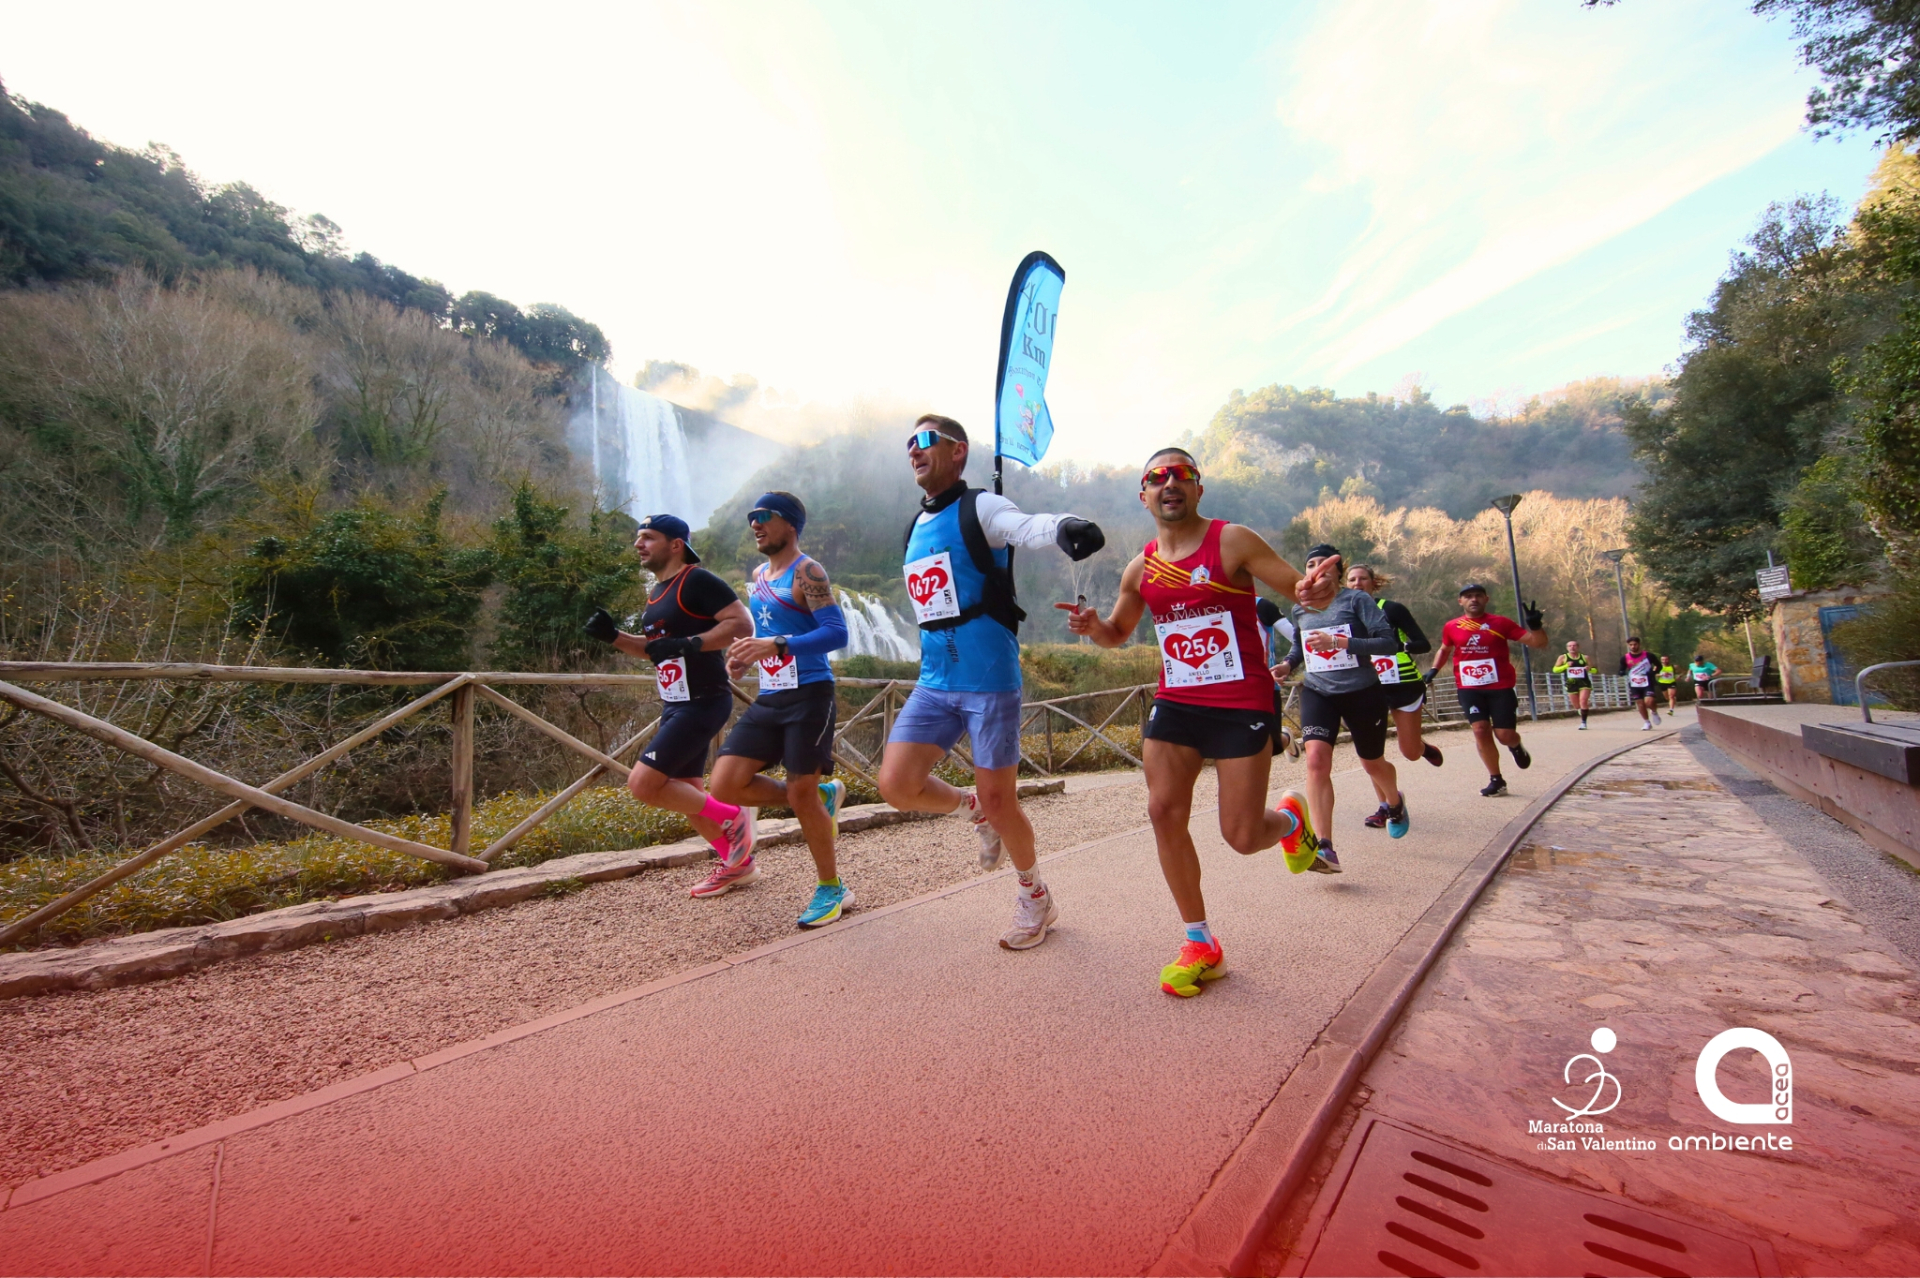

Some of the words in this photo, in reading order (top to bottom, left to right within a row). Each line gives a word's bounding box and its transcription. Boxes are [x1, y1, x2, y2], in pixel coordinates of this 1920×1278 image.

[1022, 333, 1046, 369] Km
[910, 574, 941, 599] 1672
[1172, 635, 1220, 660] 1256
[1375, 662, 1388, 671] 61
[1466, 667, 1489, 676] 1253
